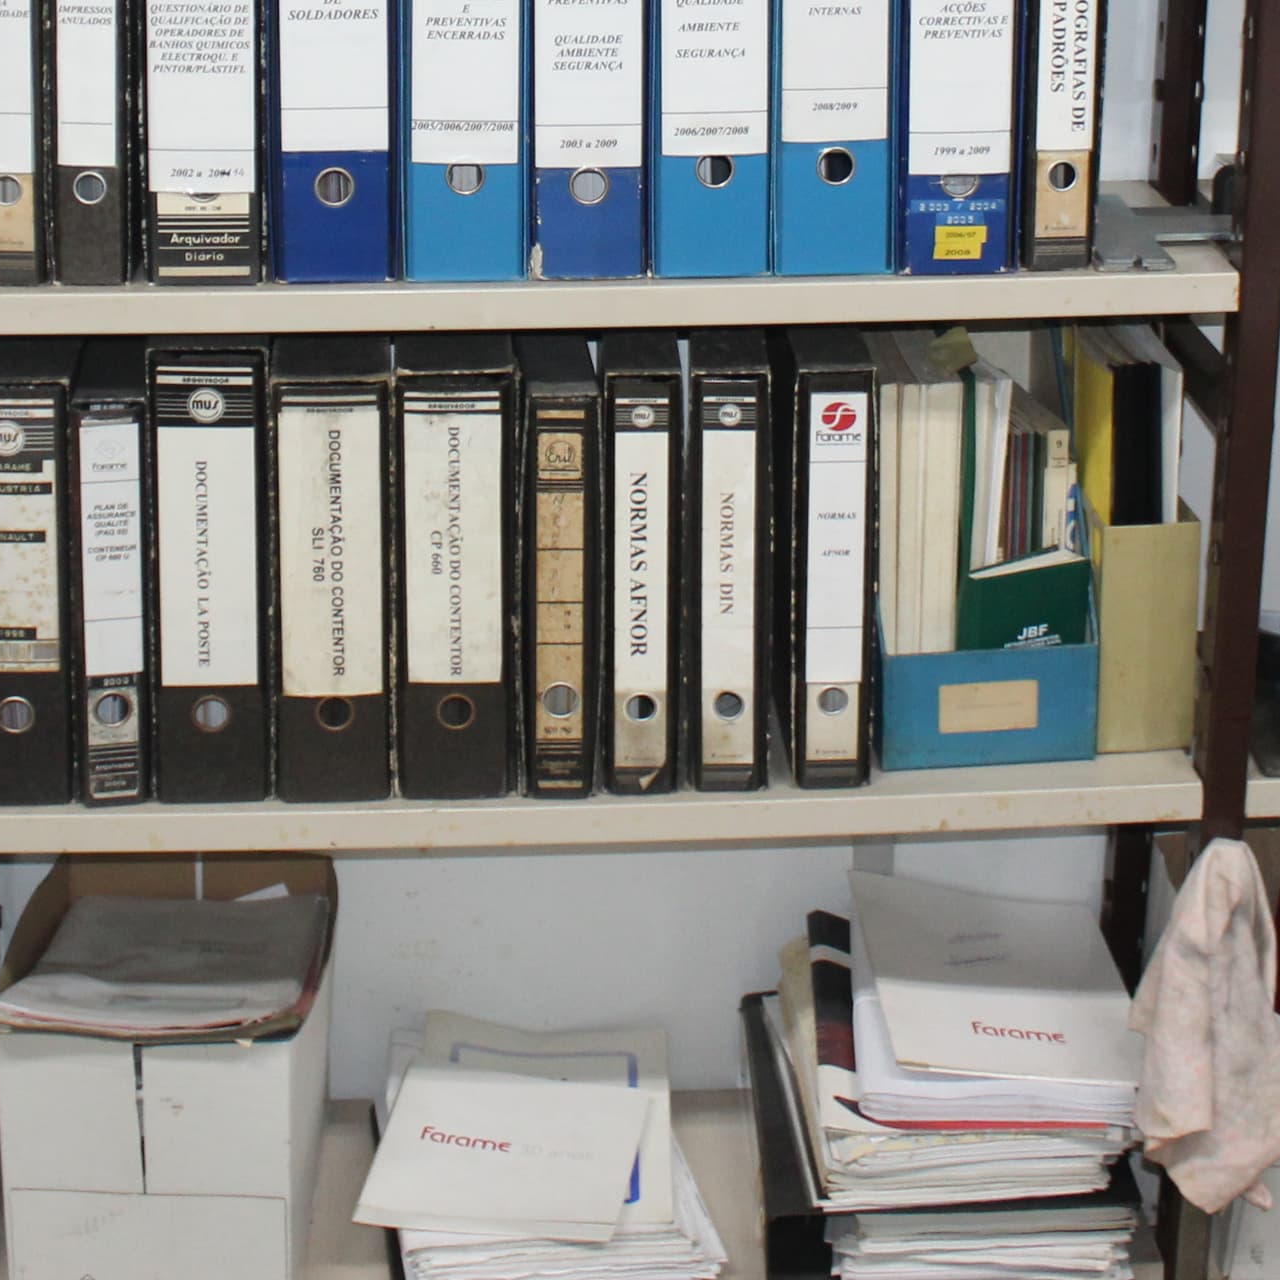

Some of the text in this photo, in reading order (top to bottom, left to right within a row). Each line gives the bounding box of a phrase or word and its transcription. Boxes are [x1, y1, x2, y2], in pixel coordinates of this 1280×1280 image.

[58, 4, 114, 15] IMPRESSOS
[149, 3, 249, 15] QUESTIONÁRIO DE
[288, 9, 379, 20] SOLDADORES
[808, 6, 862, 16] INTERNAS
[60, 16, 112, 25] ANULADOS
[149, 14, 249, 28] QUALIFICAÇÃO DE
[425, 17, 507, 27] PREVENTIVAS
[154, 28, 245, 38] OPERADORES DE
[679, 22, 739, 32] AMBIENTE
[426, 30, 505, 40] ENCERRADAS
[149, 40, 193, 50] BANHOS
[1051, 1, 1068, 93] PADRÕES
[675, 48, 746, 59] SEGURANÇA
[1071, 107, 1086, 131] DE
[559, 139, 618, 149] 2003 2009
[170, 232, 241, 245] Arquivador
[311, 527, 325, 582] SLI 760
[327, 429, 345, 676] DOCUMENTAÇÃO DO CONTENTOR
[430, 530, 442, 575] CP 660
[719, 493, 734, 614] NORMAS DIN
[195, 461, 212, 666] DOCUMENTAÇÃO LA POSTE
[630, 472, 648, 656] NORMAS AFNOR
[1017, 624, 1050, 642] JBF
